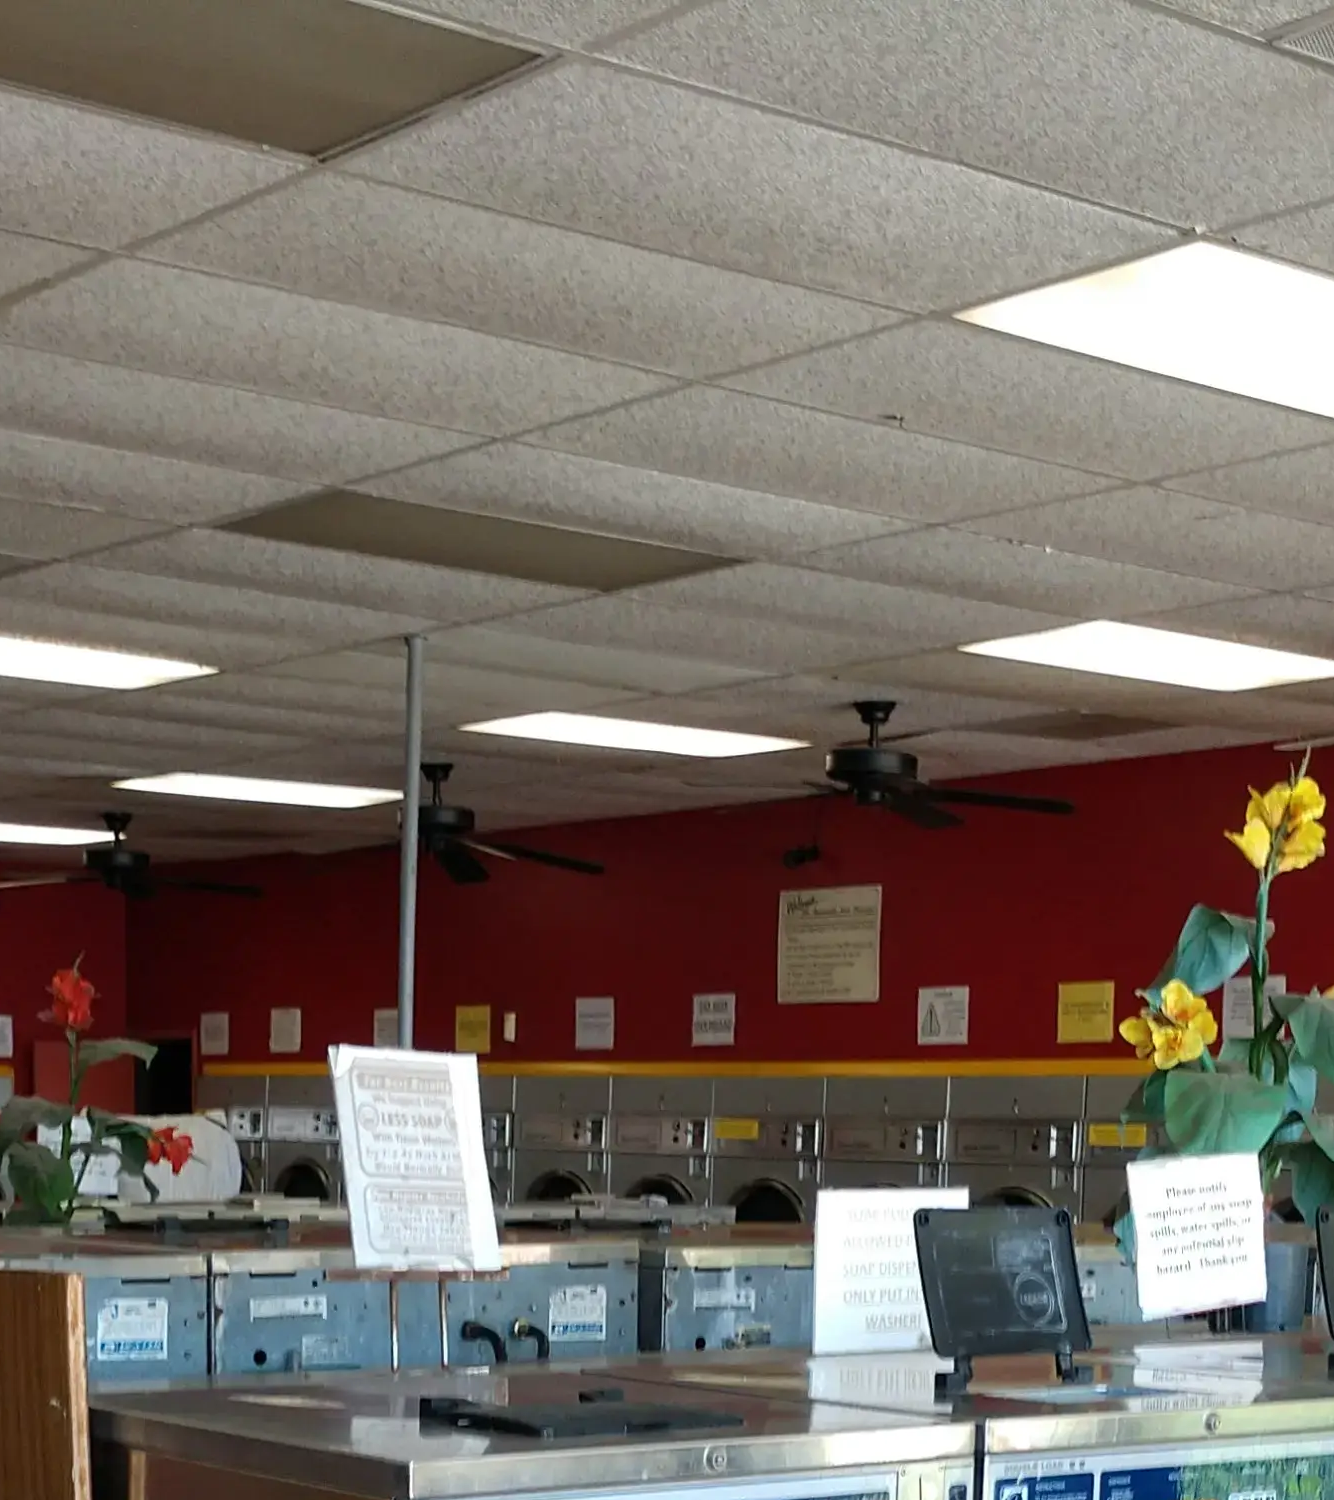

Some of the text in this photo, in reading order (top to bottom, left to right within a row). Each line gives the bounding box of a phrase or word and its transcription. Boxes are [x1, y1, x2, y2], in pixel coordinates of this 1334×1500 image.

[380, 1111, 443, 1129] LESS SOAP
[1166, 1181, 1228, 1200] Please notify
[1146, 1206, 1194, 1222] employee
[1197, 1203, 1207, 1213] of
[1181, 1223, 1208, 1235] water
[843, 1261, 918, 1278] SOAP DISPEN
[843, 1290, 877, 1305] ONLY
[879, 1288, 905, 1304] PUT
